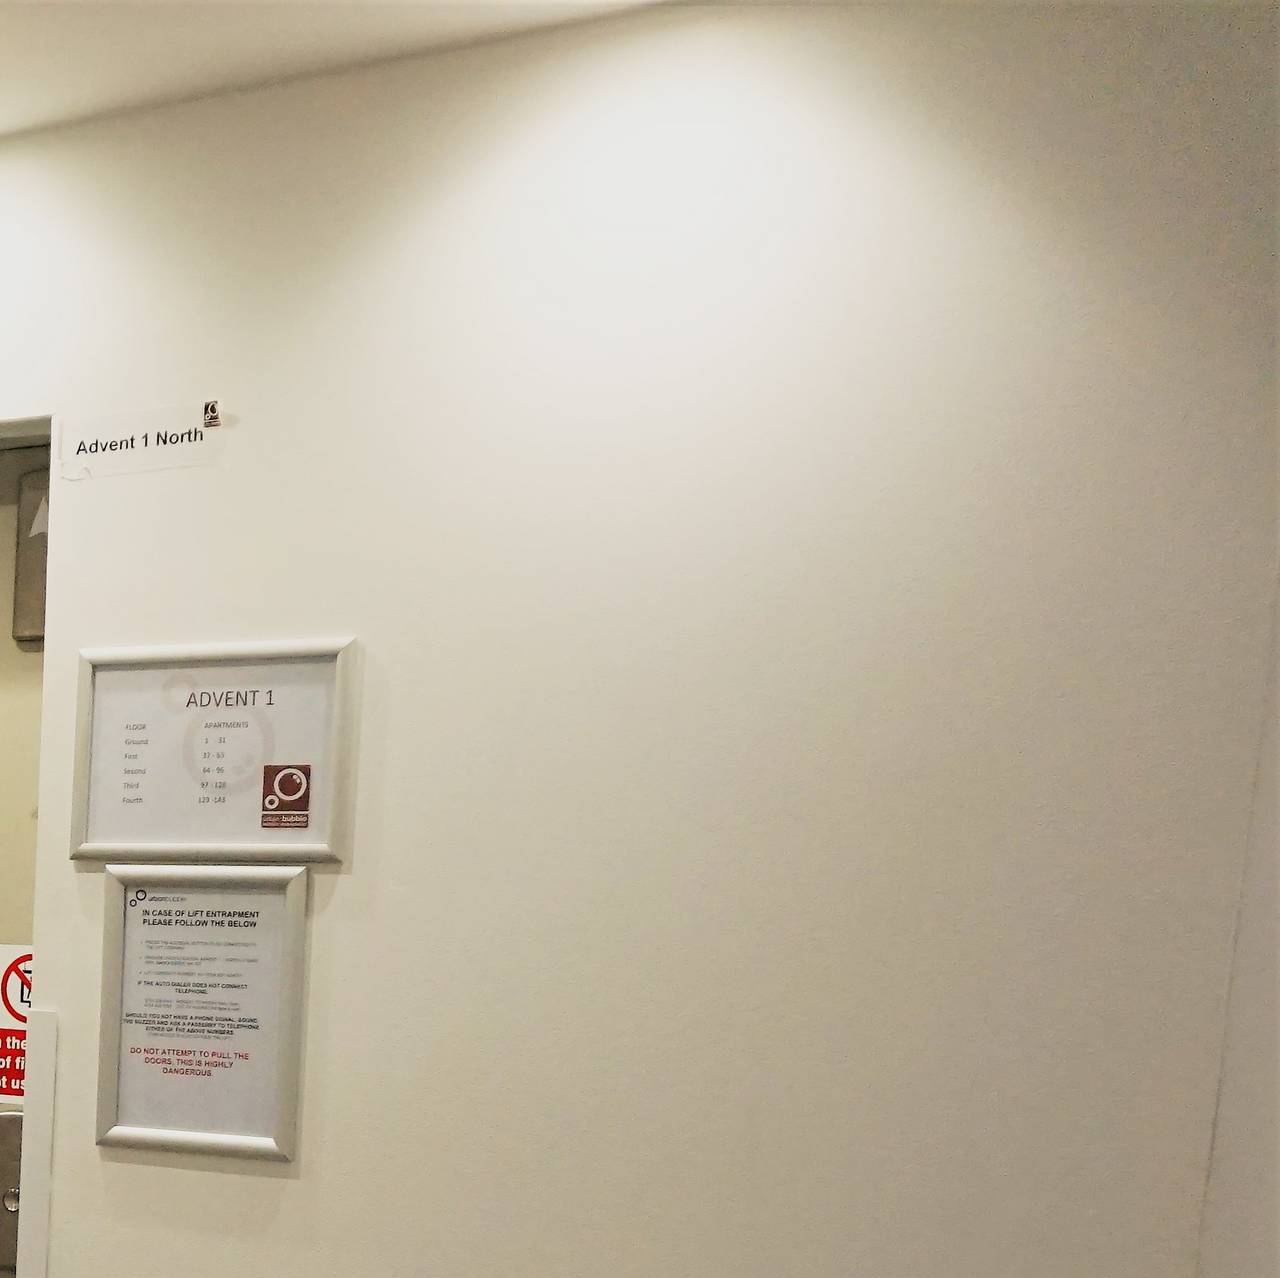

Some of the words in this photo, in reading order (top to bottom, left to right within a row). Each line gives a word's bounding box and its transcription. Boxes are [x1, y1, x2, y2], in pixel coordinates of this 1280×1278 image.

[76, 435, 135, 455] Advent
[142, 433, 148, 447] 1
[157, 427, 203, 446] North
[186, 690, 259, 708] ADVENT
[266, 689, 275, 705] 1
[175, 919, 208, 927] FOLLOW
[228, 920, 257, 928] BELOW
[6, 1036, 26, 1050] the
[144, 1047, 160, 1055] NOT
[211, 1051, 231, 1059] PULL
[234, 1052, 249, 1060] THE
[15, 1056, 24, 1070] fi
[176, 1058, 193, 1066] THIS
[205, 1061, 233, 1069] HIGHLY
[11, 1079, 24, 1089] us
